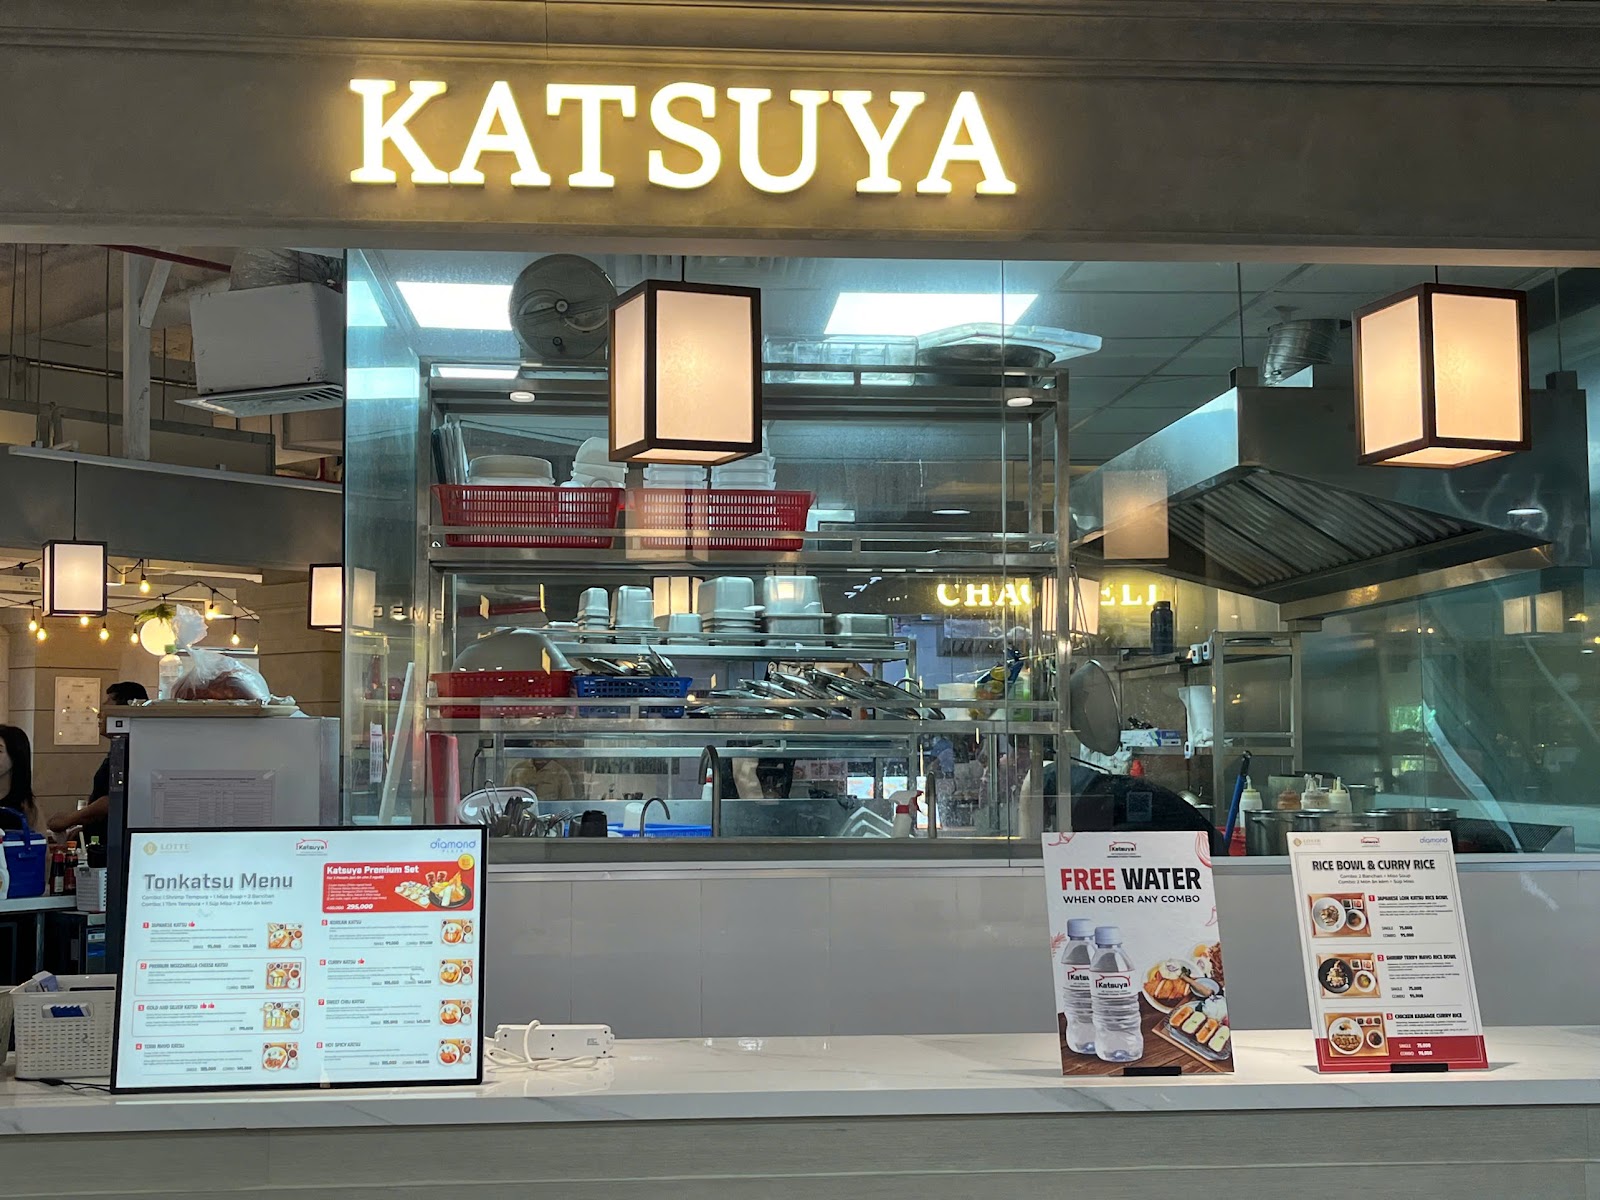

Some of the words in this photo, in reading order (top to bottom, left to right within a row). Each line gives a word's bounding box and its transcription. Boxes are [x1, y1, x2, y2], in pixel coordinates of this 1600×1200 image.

[348, 77, 1018, 195] KATSUYA
[298, 844, 325, 852] Katsuya
[430, 838, 476, 849] diamond
[327, 866, 362, 876] Katsuya
[364, 866, 402, 874] Premium
[404, 865, 419, 873] Set
[1312, 861, 1334, 871] RICE
[1337, 860, 1366, 870] BOWL
[1368, 860, 1376, 870] &
[1378, 860, 1411, 870] CURRY
[1414, 859, 1436, 869] RICE
[144, 873, 233, 891] Tonkatsu
[241, 872, 293, 890] Menu
[1060, 868, 1117, 891] FREE
[1121, 867, 1202, 890] WATER
[1063, 896, 1096, 904] WHEN
[1099, 896, 1135, 904] ORDER
[1161, 895, 1200, 903] COMBO
[1098, 981, 1128, 990] Katsuya
